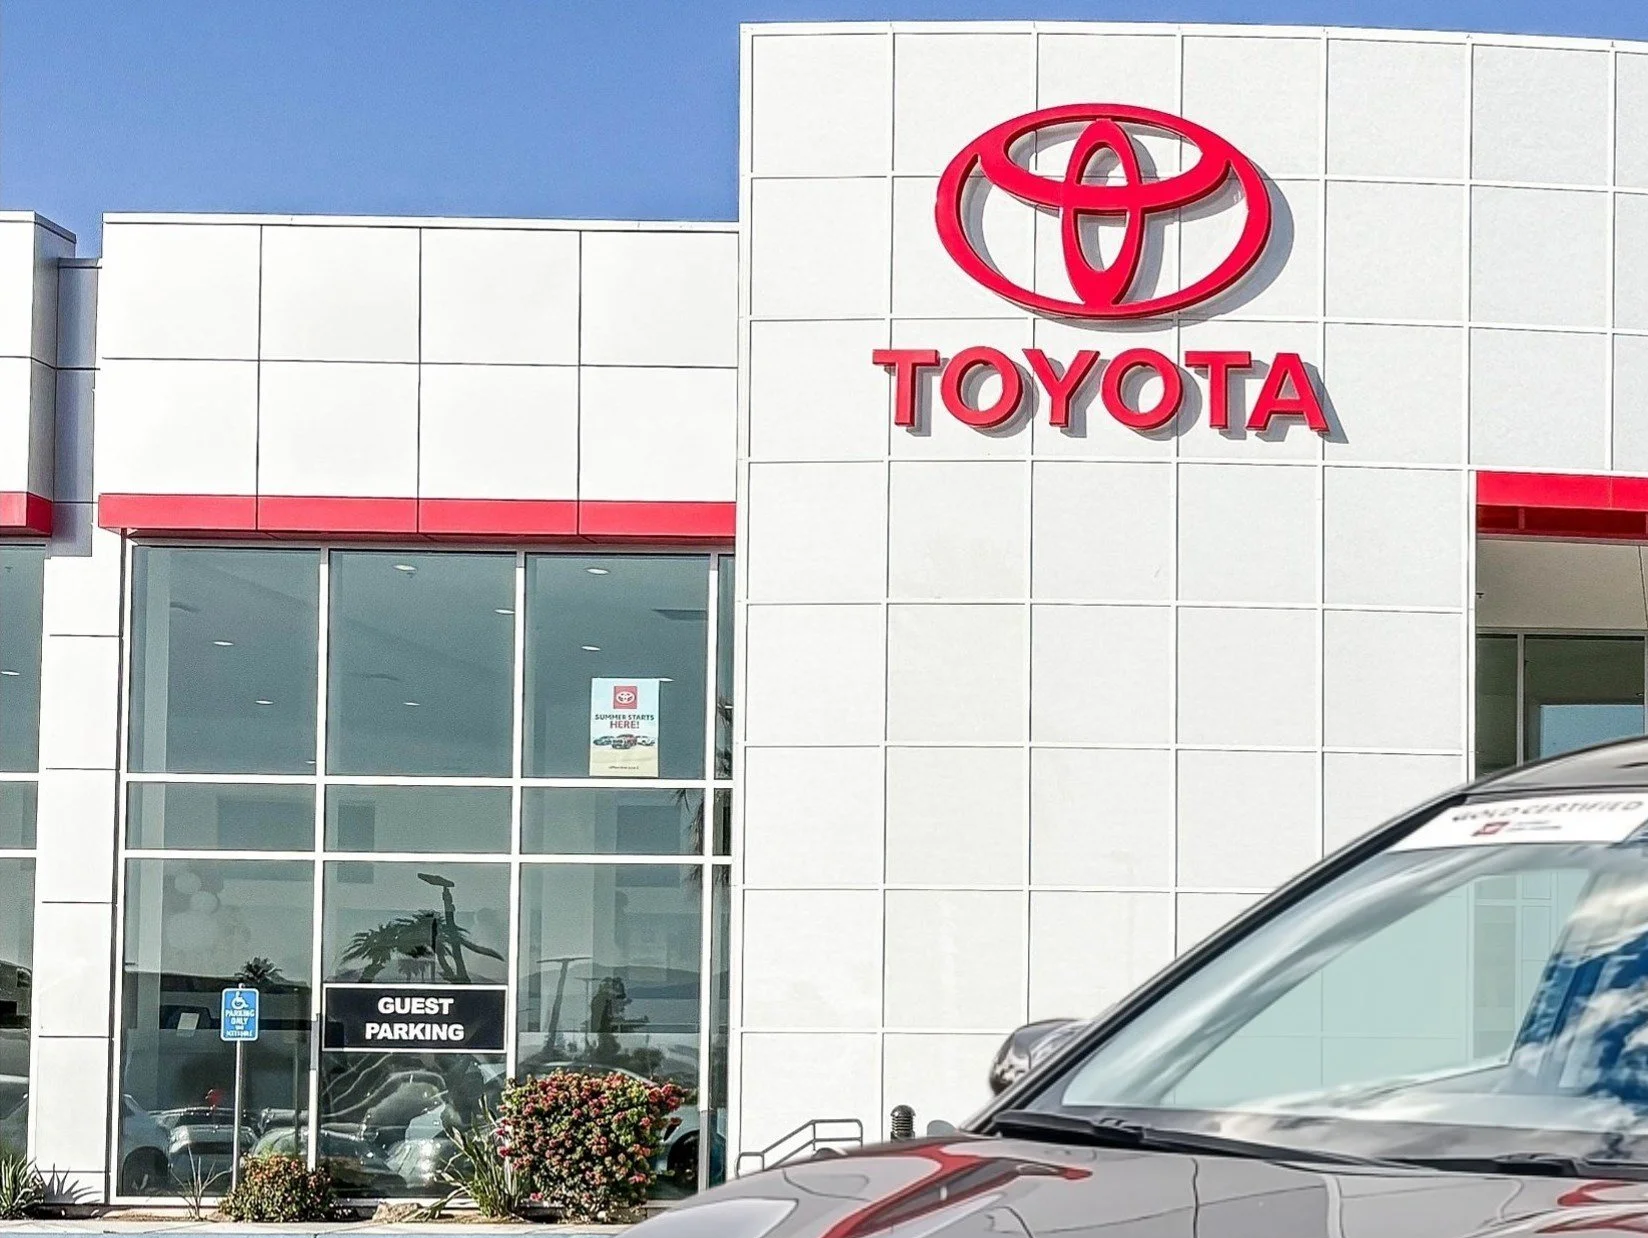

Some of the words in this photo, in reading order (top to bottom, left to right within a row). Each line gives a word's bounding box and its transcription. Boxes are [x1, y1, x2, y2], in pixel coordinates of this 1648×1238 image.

[872, 346, 1329, 432] TOYOTA
[610, 721, 640, 729] HERE!
[377, 997, 455, 1015] GUEST
[225, 1009, 255, 1017] PARKING
[231, 1017, 249, 1025] ONLY
[365, 1022, 465, 1041] PARKING
